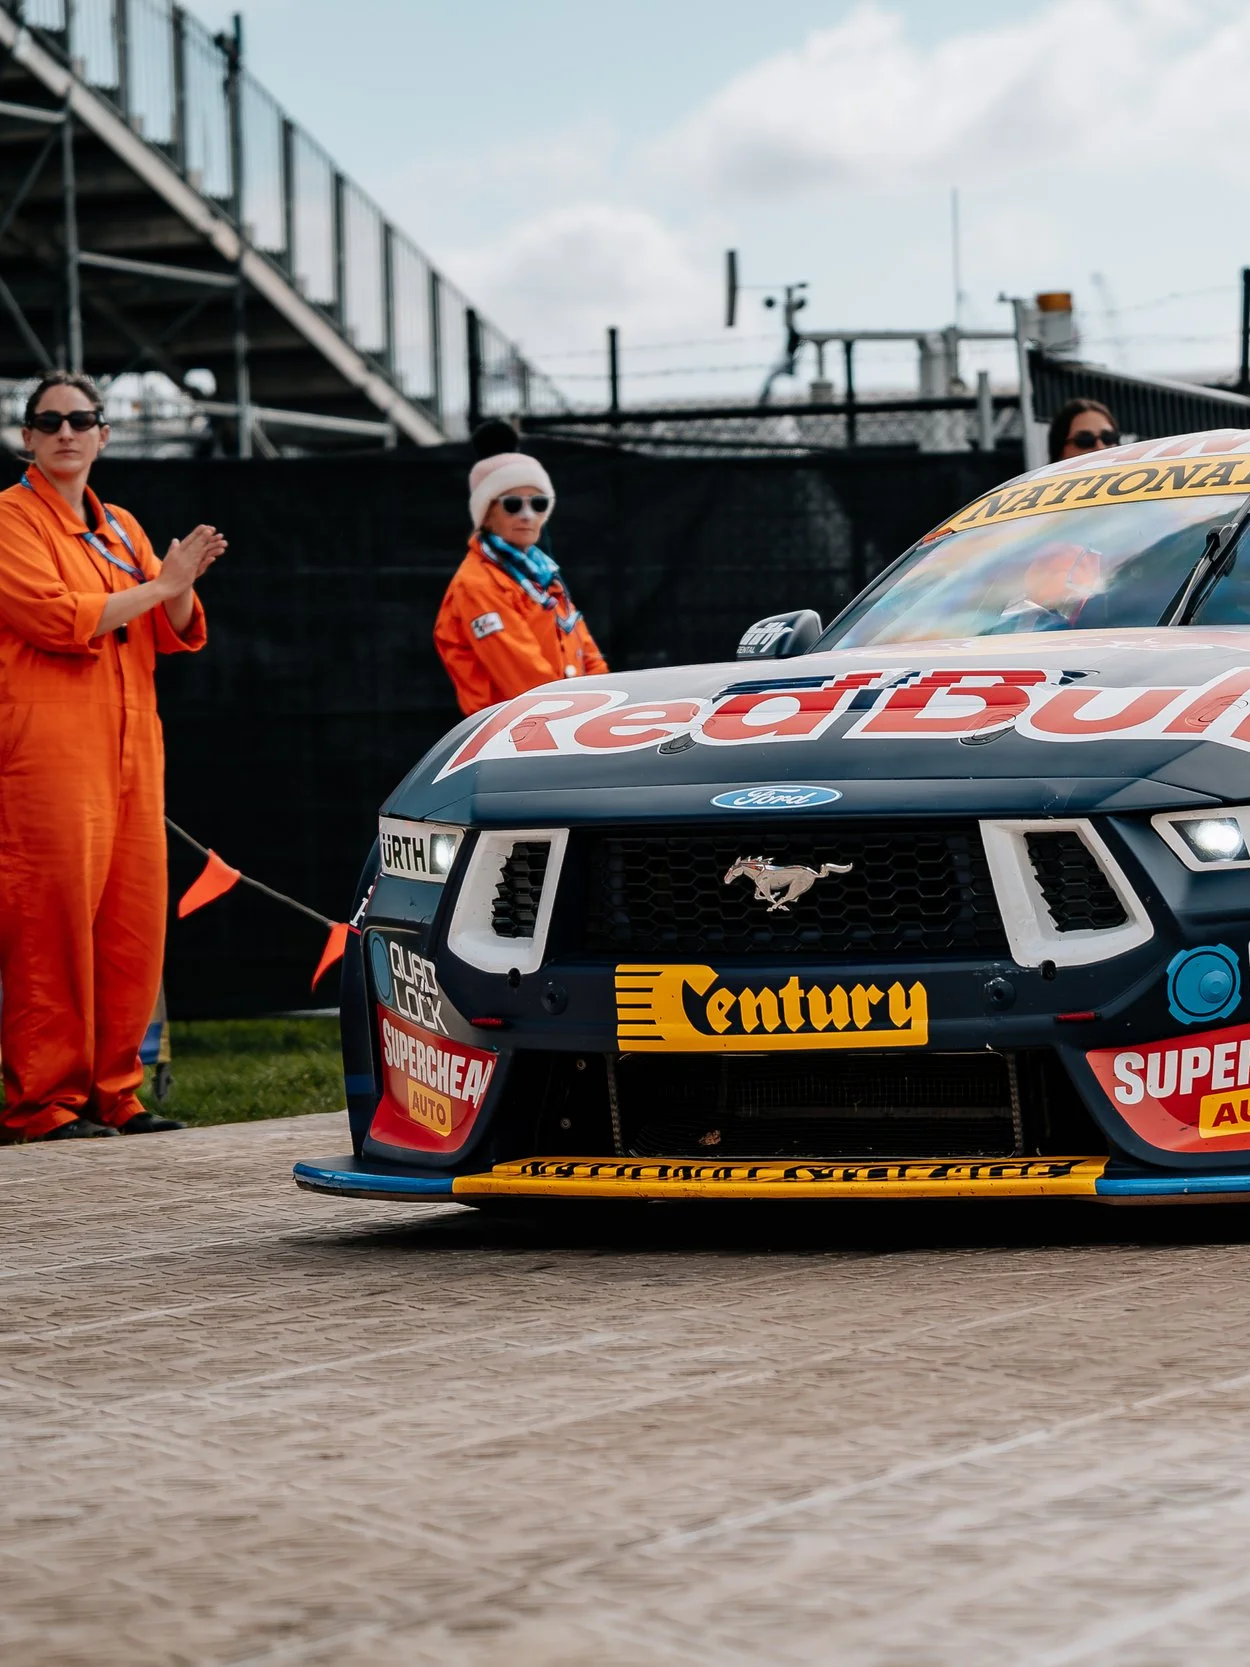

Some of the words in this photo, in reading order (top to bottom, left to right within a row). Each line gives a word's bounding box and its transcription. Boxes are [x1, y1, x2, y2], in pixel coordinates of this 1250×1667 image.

[733, 788, 817, 806] Ford
[382, 832, 427, 873] ÜRTH
[388, 940, 439, 996] QUAD
[393, 978, 450, 1036] LOCK
[614, 963, 928, 1053] Century
[411, 1090, 447, 1127] AUTO
